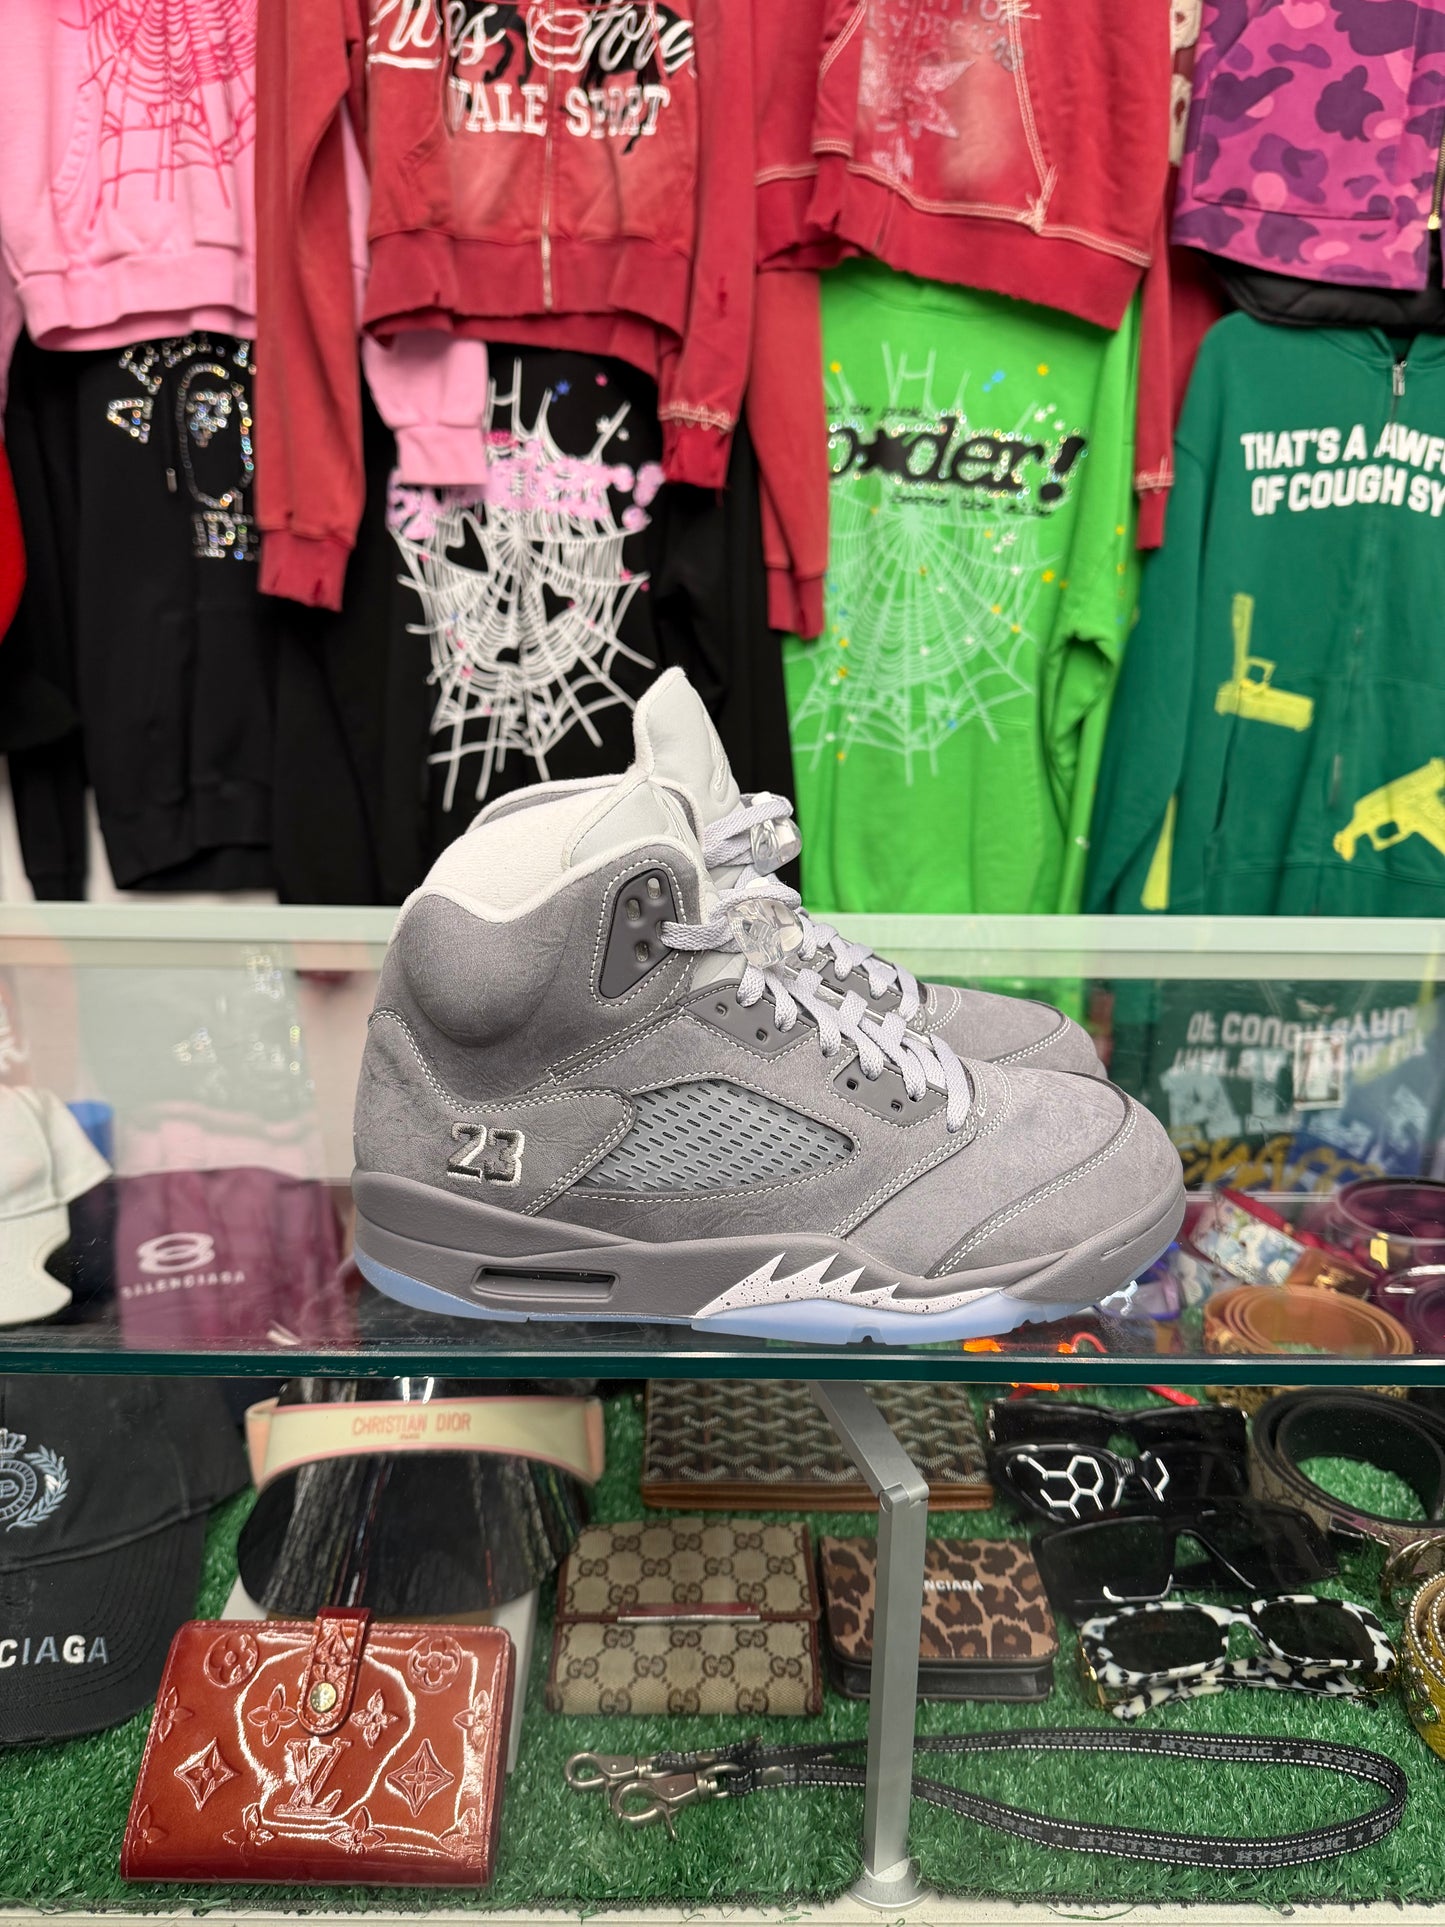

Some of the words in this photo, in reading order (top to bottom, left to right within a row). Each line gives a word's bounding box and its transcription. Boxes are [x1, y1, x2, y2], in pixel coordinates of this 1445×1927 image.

[1240, 427, 1342, 471] THAT'S
[1342, 424, 1367, 461] A
[1251, 475, 1287, 516] OF
[1288, 465, 1408, 512] COUGH
[447, 1122, 526, 1187] 23
[352, 1414, 428, 1437] CHRISTIAN
[436, 1410, 471, 1432] DIOR
[0, 1634, 109, 1669] CIAGA
[1160, 1738, 1273, 1756] HYSTERIC
[1235, 1834, 1347, 1864] HYSTERIC
